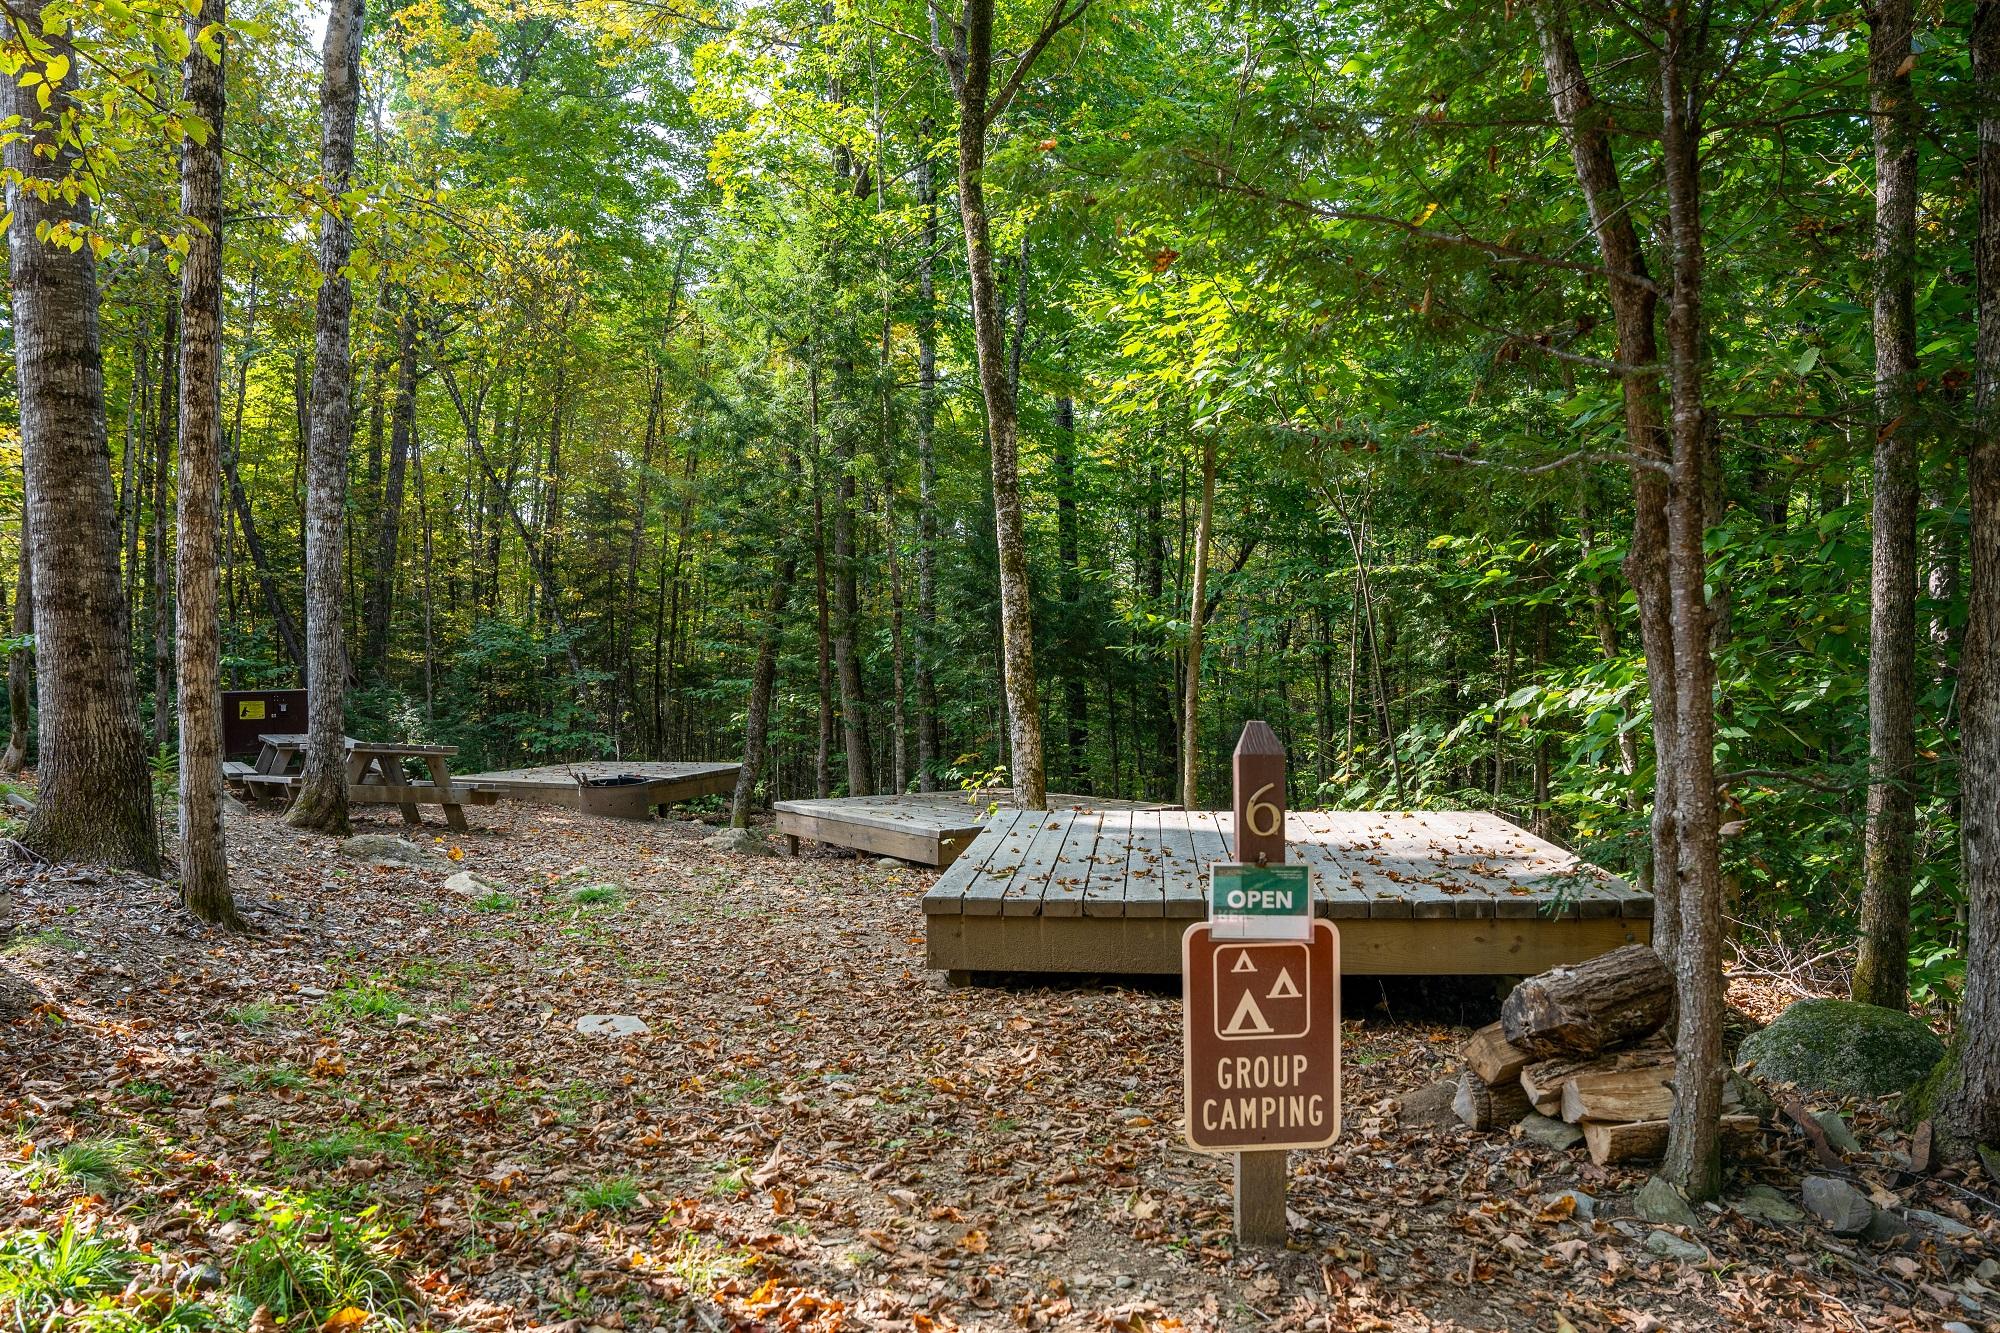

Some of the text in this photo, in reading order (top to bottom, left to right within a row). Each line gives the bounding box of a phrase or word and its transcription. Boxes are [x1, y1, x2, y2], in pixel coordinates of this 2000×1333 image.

[1246, 782, 1281, 836] 6
[1227, 890, 1293, 909] OPEN
[1217, 1054, 1308, 1090] GROUP
[1202, 1094, 1323, 1131] CAMPING
